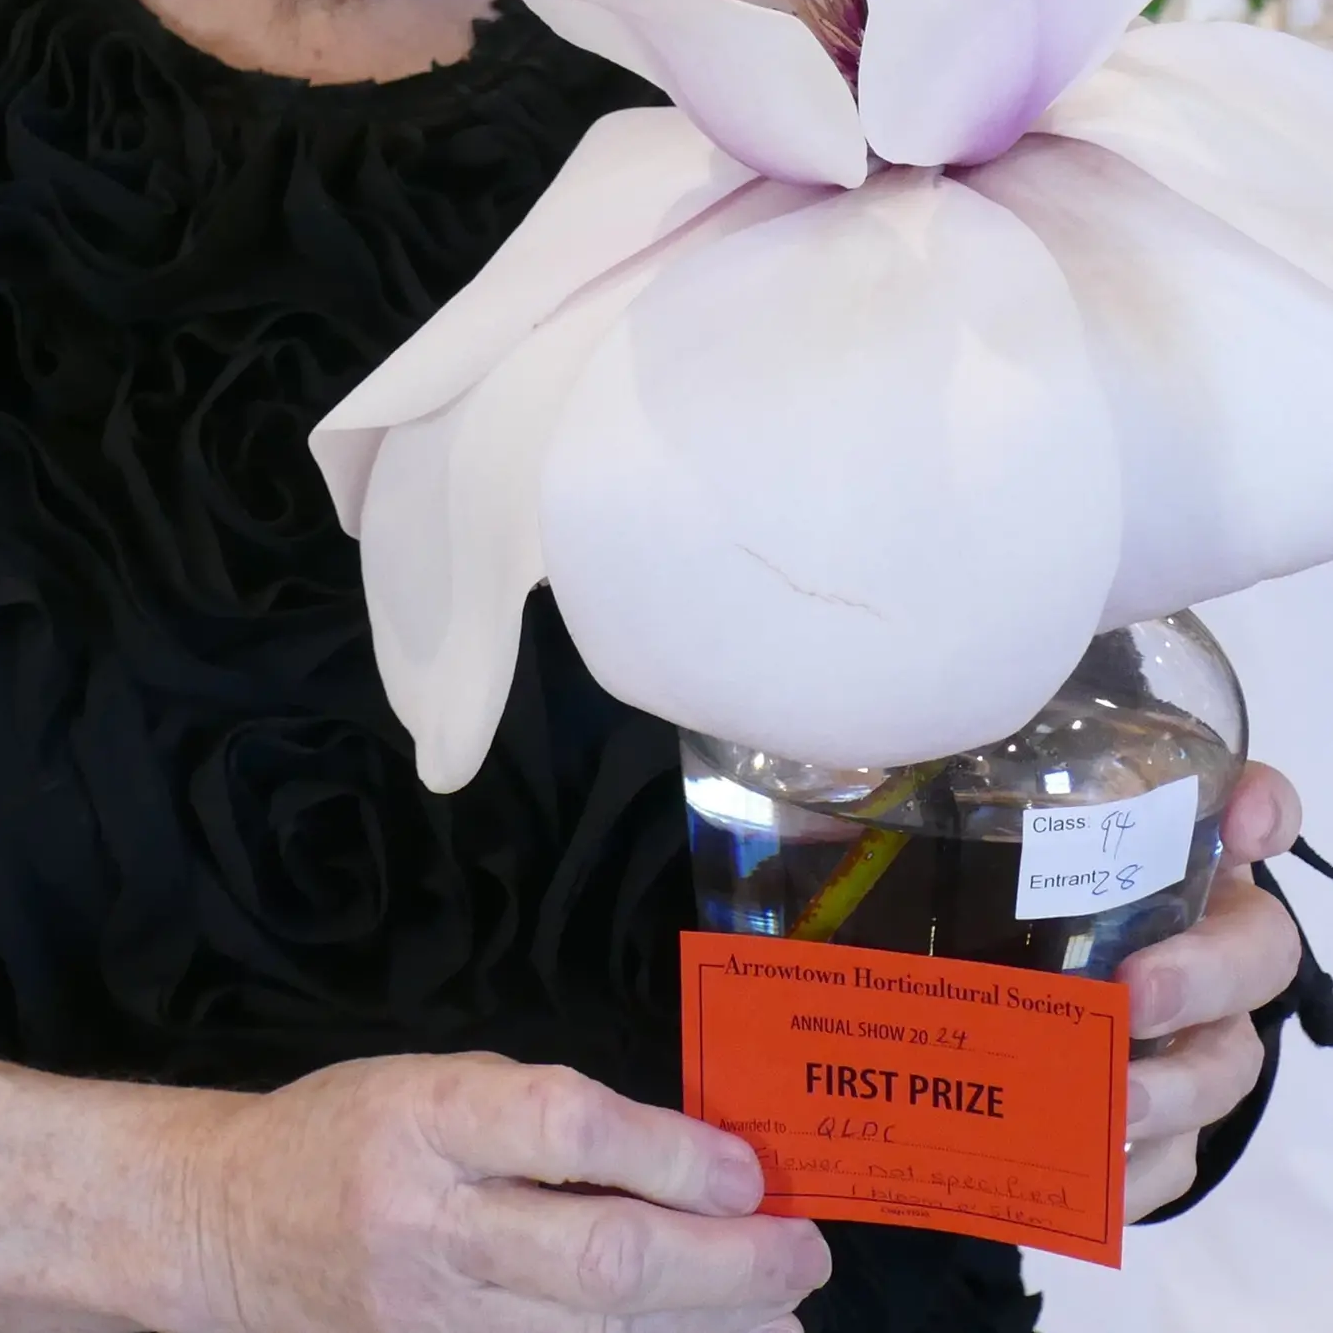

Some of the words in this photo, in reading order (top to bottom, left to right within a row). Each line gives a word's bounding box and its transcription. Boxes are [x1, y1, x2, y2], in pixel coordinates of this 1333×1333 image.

[1101, 810, 1136, 860] 94
[1030, 870, 1097, 890] Entrant
[1092, 864, 1143, 896] 28
[724, 953, 846, 986] Arrowtown
[853, 966, 1000, 1006] Horticultural
[1007, 987, 1085, 1024] Society
[790, 1015, 854, 1037] ANNUAL
[858, 1021, 906, 1042] SHOW
[806, 1062, 899, 1103] FIRST
[909, 1073, 1004, 1119] PRIZE
[719, 1118, 771, 1135] Awarded
[773, 1120, 787, 1135] to
[817, 1117, 898, 1143] QLDC
